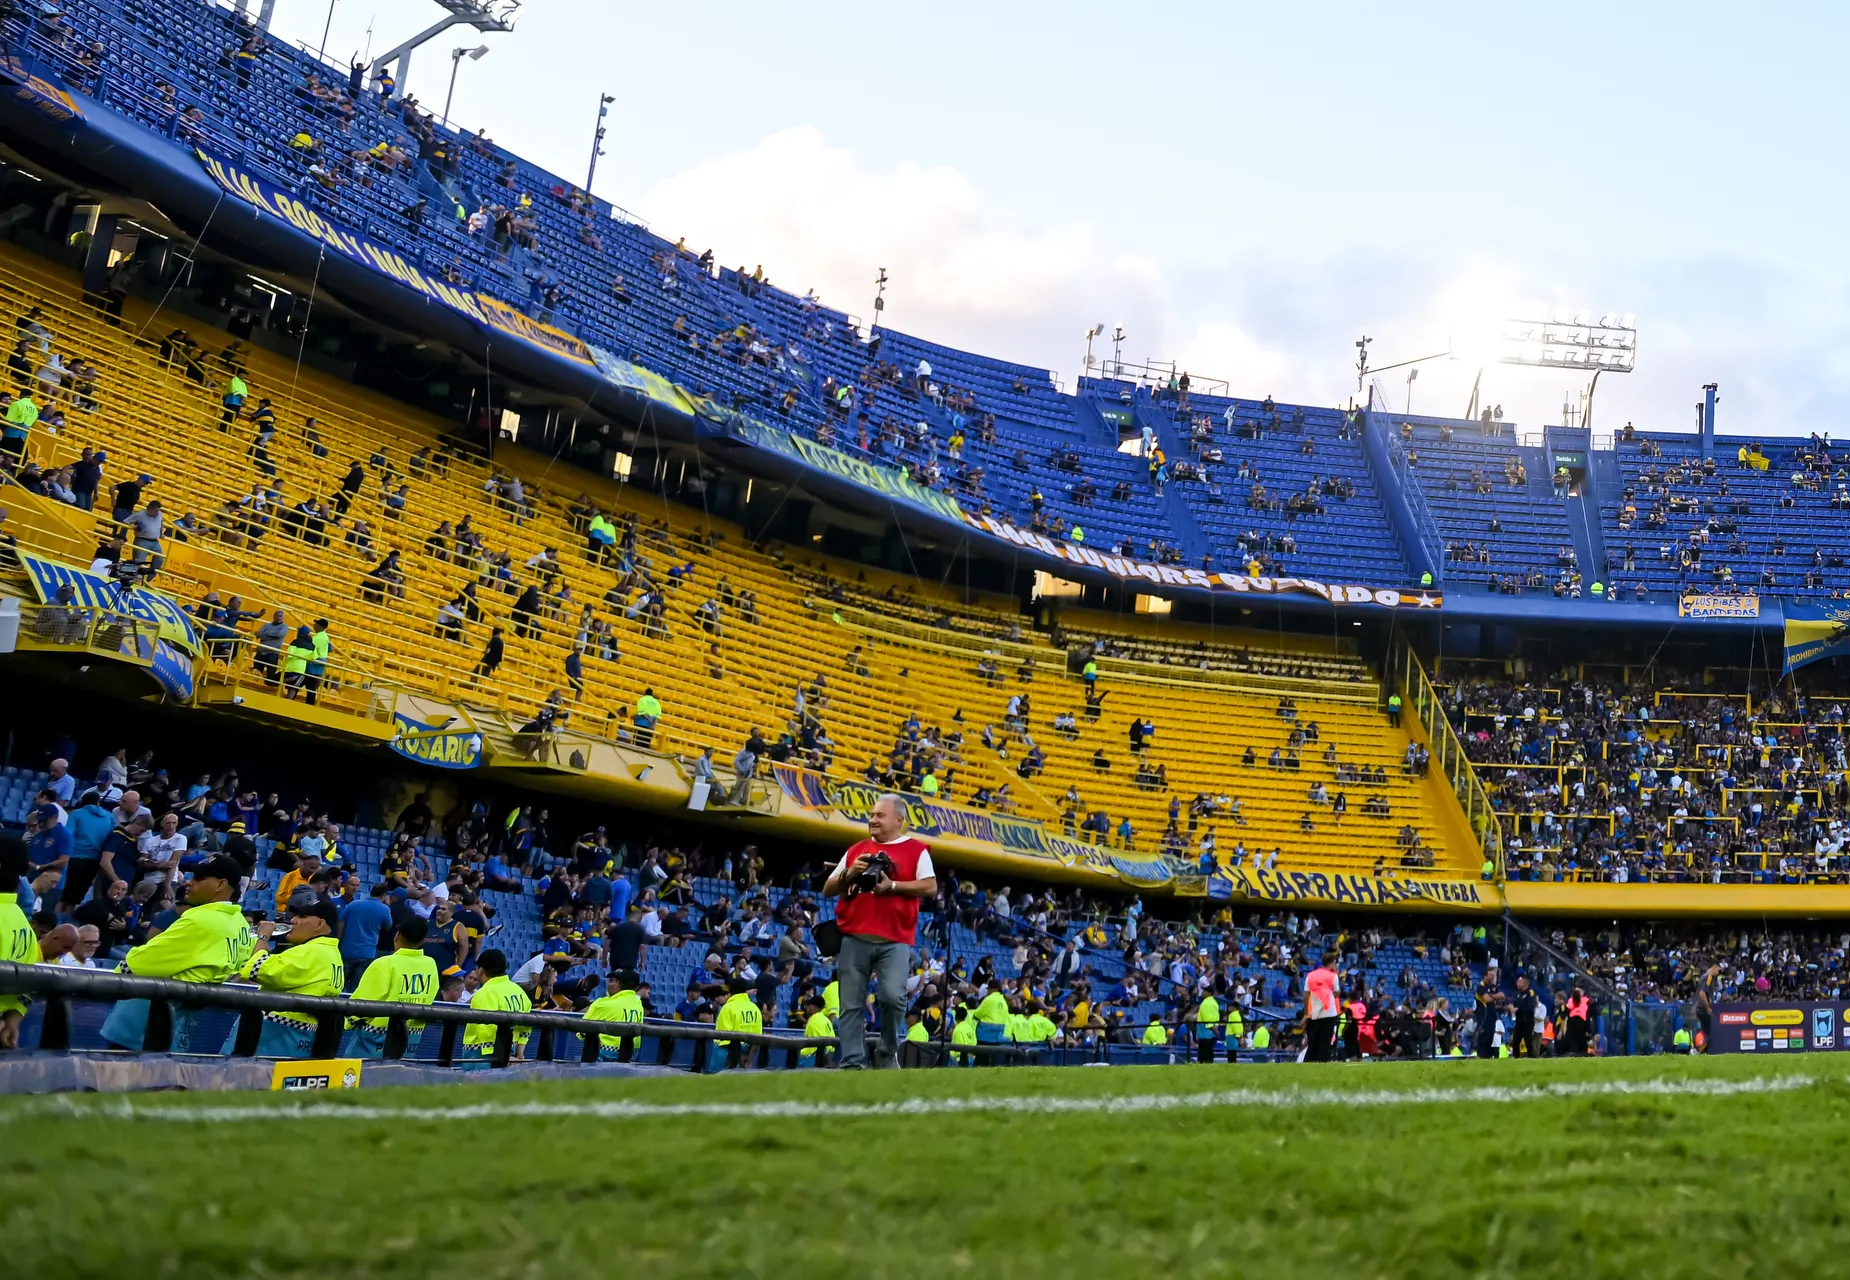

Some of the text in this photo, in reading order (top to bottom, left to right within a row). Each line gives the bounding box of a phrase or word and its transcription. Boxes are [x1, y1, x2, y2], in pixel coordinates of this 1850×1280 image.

[981, 514, 1063, 558] BOCA
[1064, 544, 1212, 589] JUNIORS
[1694, 598, 1711, 607] LOS
[1712, 597, 1742, 608] PIBES
[1786, 646, 1825, 666] PROHIBIDO
[1814, 1036, 1833, 1047] LPF
